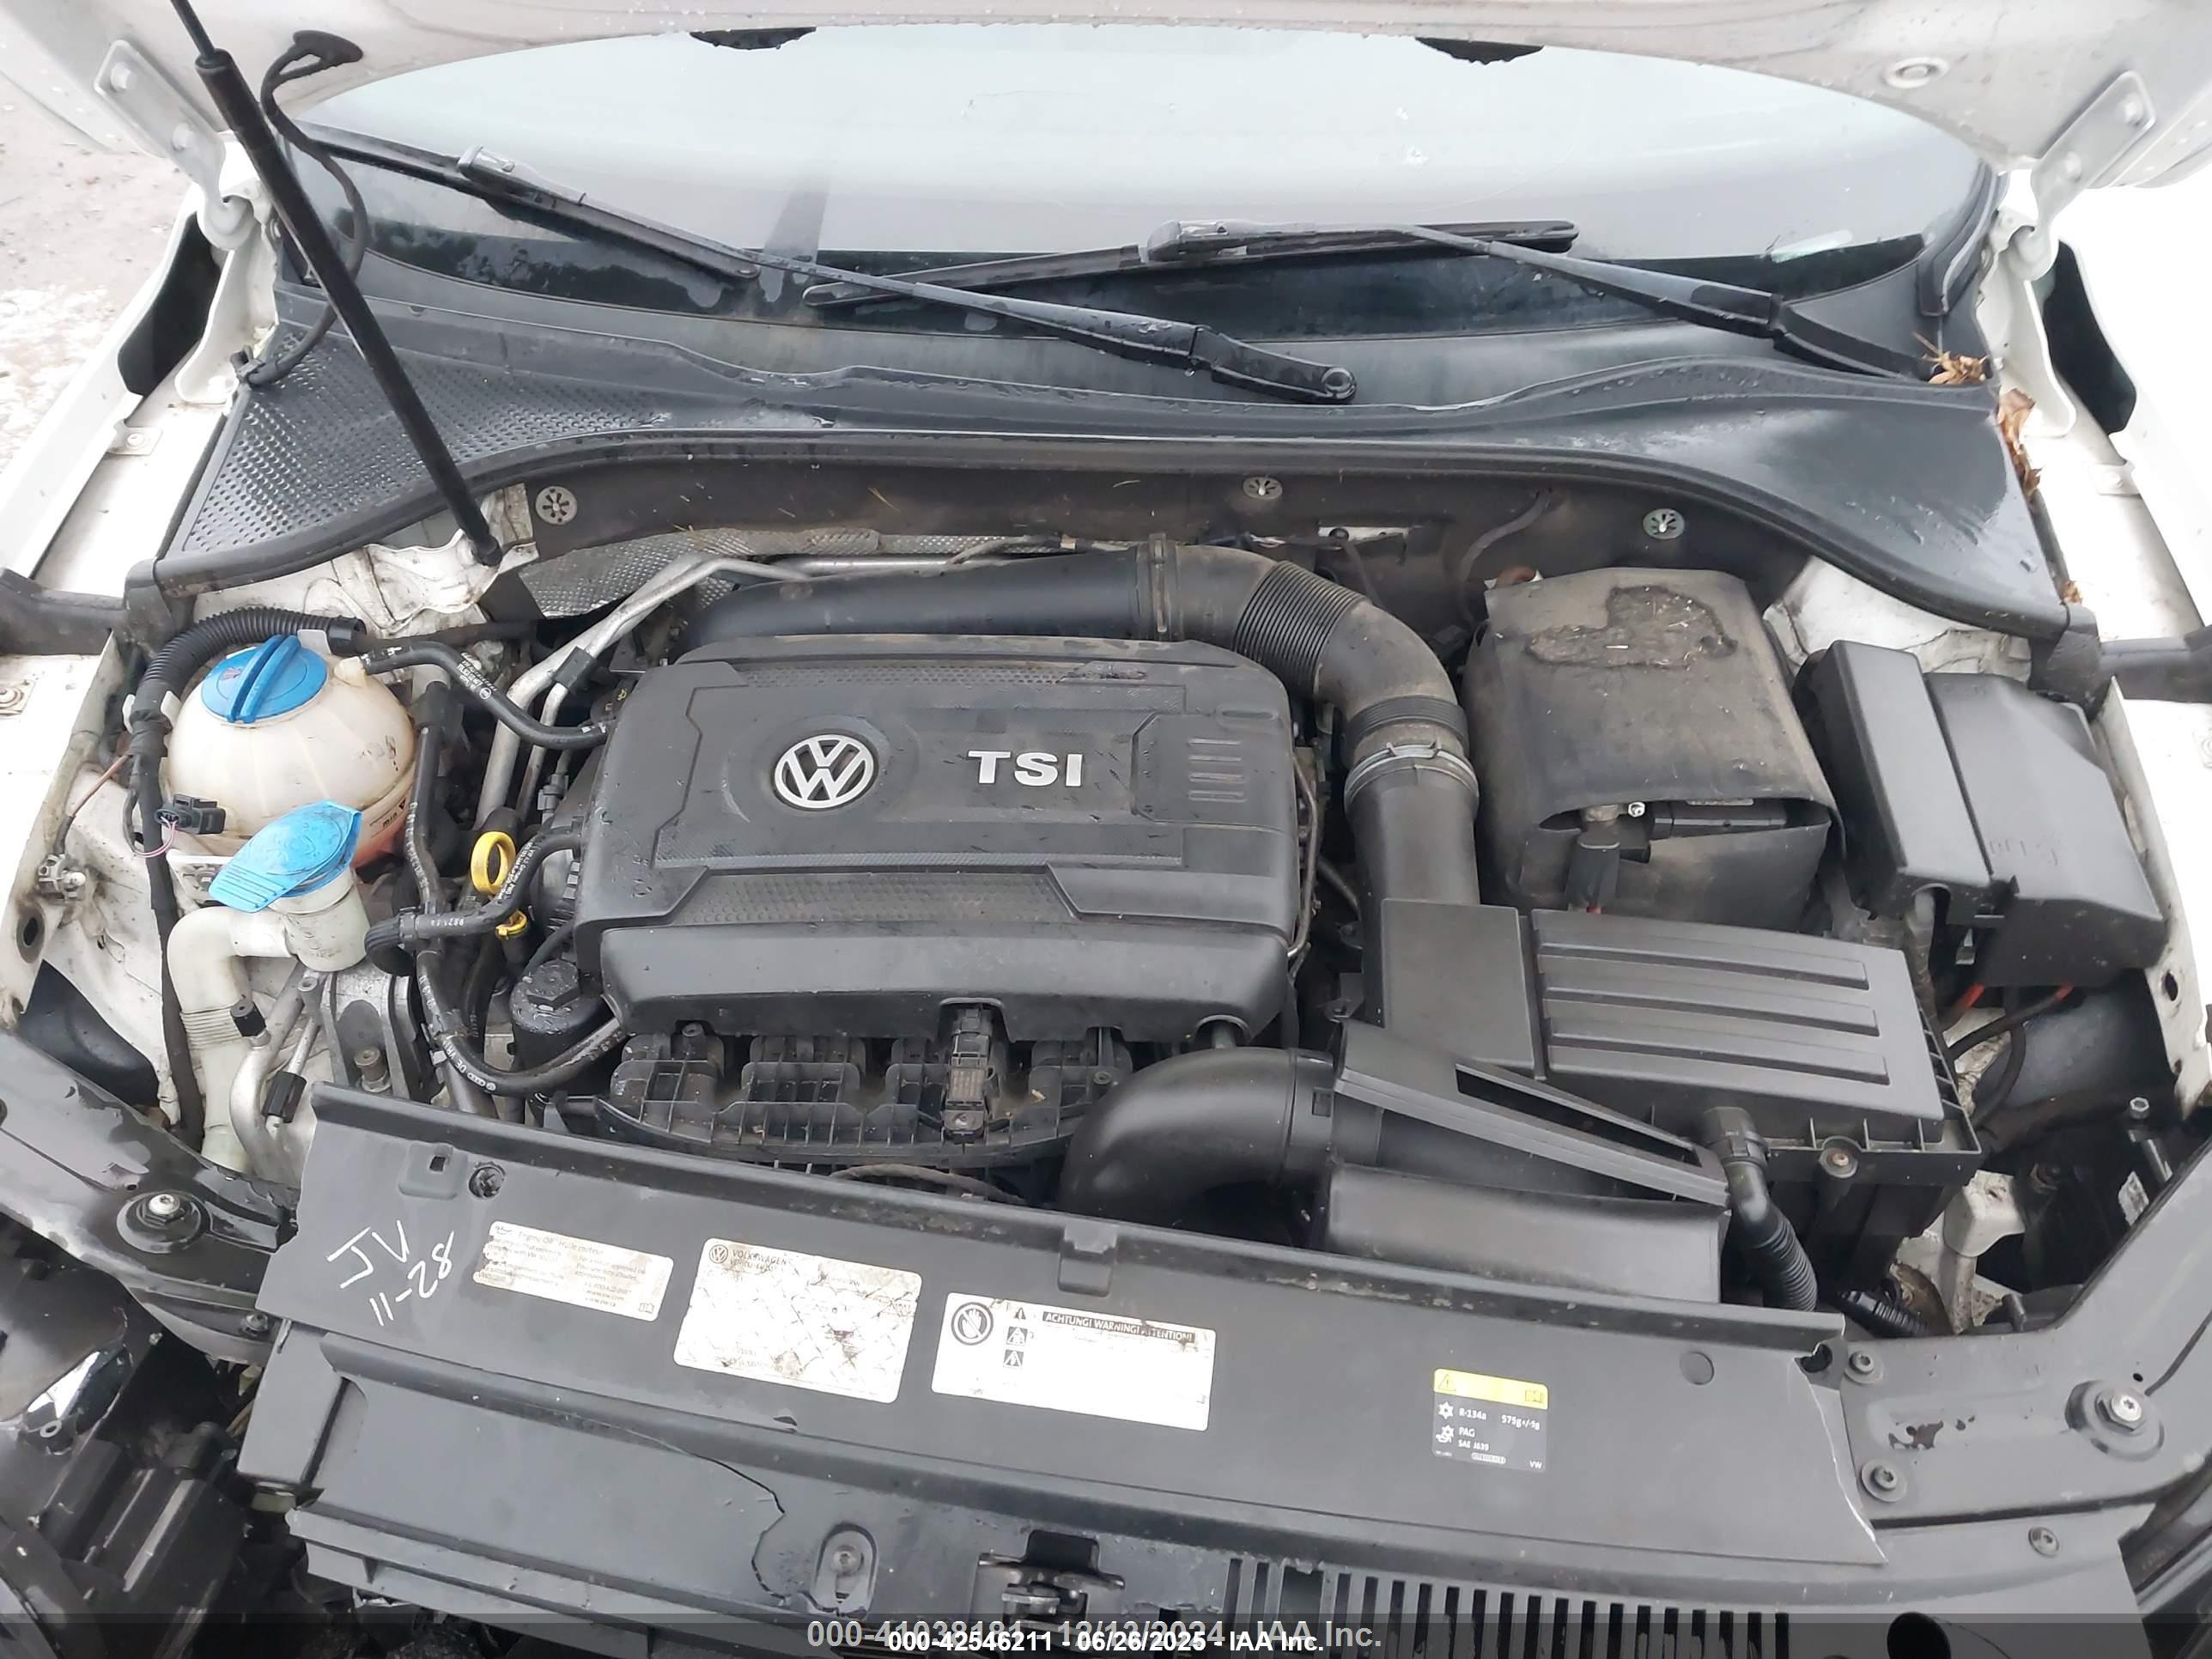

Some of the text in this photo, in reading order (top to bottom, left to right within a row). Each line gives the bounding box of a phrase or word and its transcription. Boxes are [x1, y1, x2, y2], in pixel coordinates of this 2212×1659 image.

[968, 750, 1083, 787] TSI
[326, 1219, 410, 1289] JV
[368, 1231, 455, 1327] 11-28
[1094, 1320, 1139, 1334] WARNING!
[1141, 1328, 1193, 1343] TTENTION!
[1459, 1407, 1486, 1419] R-134a
[1459, 1427, 1475, 1437] PAG
